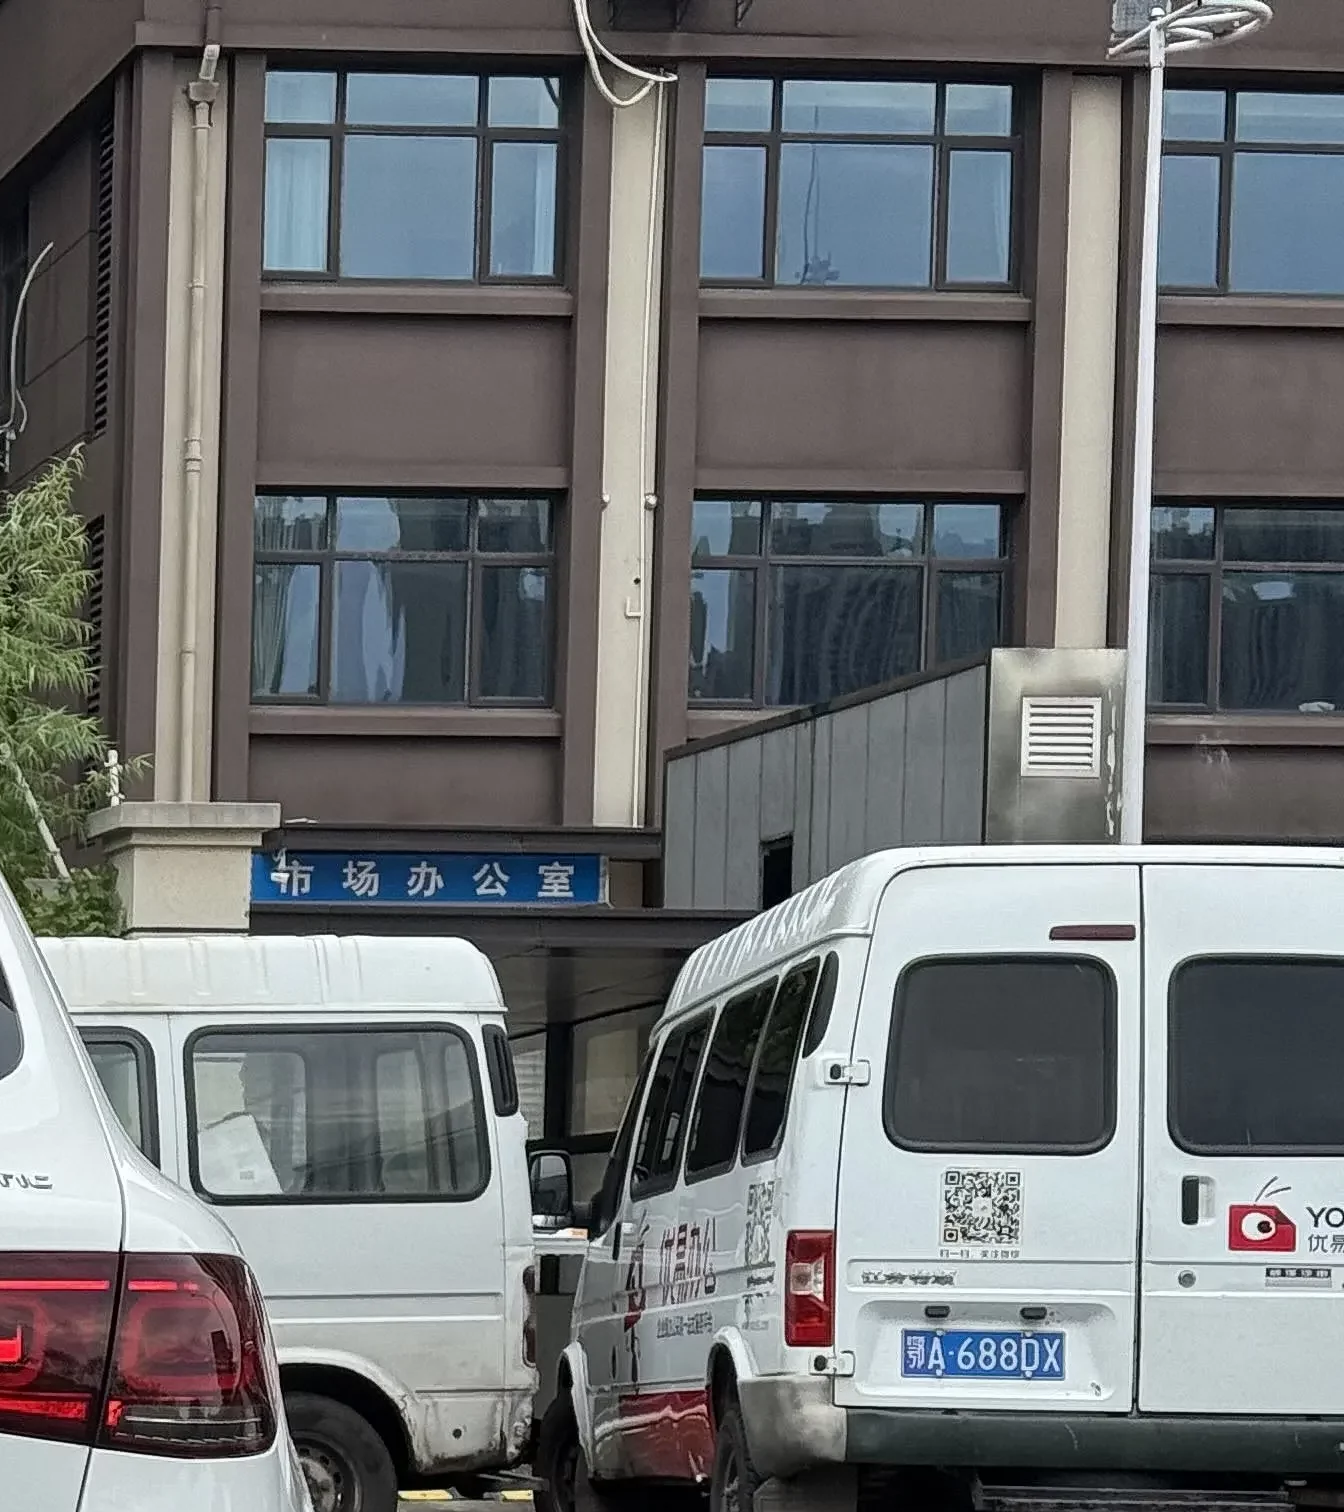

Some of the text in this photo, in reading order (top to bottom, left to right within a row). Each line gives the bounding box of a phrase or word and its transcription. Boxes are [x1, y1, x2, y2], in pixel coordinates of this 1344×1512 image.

[279, 860, 576, 897] 市场办公室
